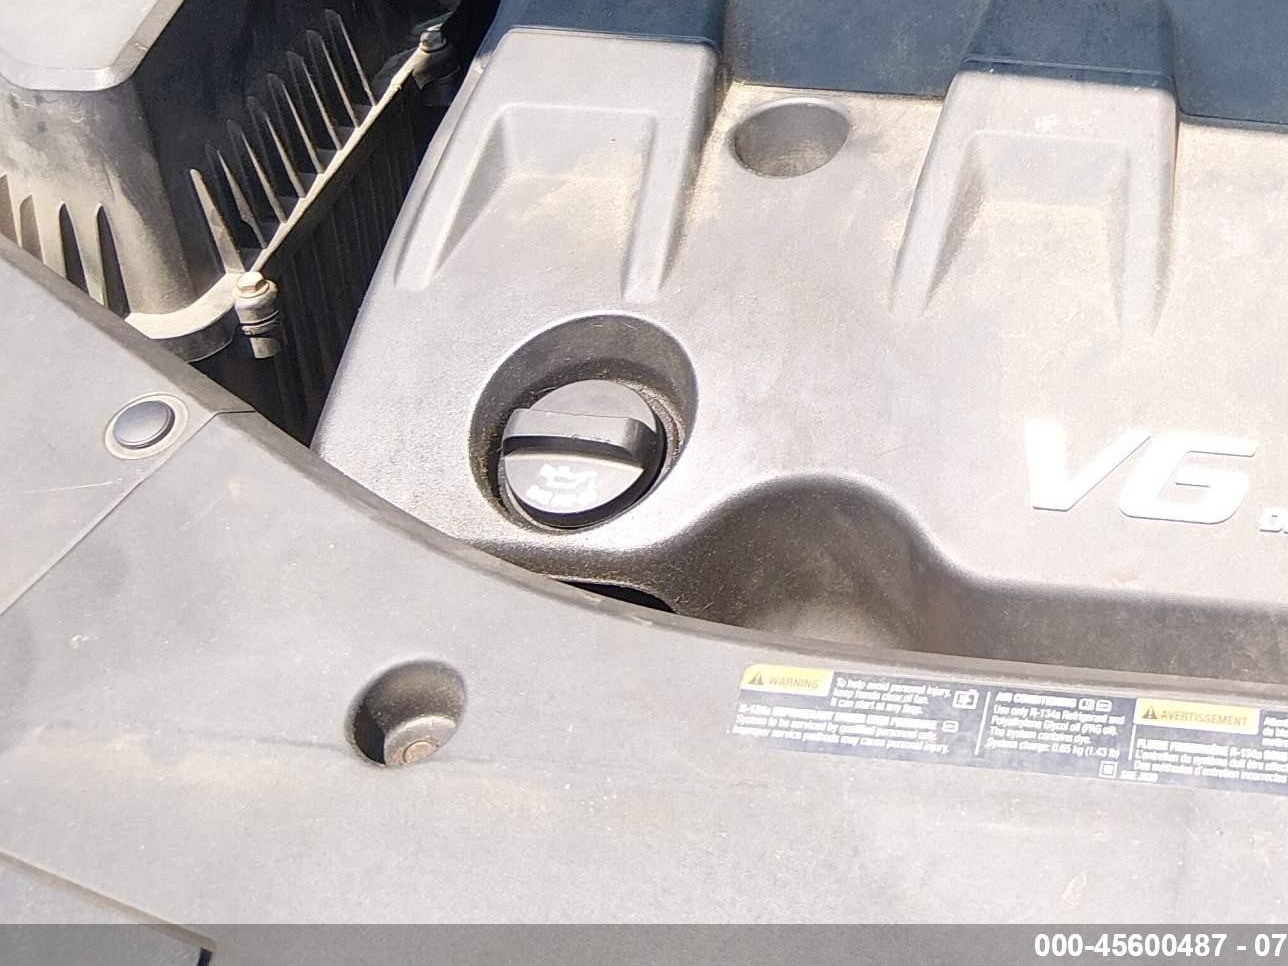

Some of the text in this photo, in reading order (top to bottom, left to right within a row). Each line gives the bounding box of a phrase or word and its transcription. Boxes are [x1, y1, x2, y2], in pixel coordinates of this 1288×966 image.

[1024, 420, 1259, 525] V6
[768, 676, 818, 689] WARNING
[1160, 710, 1247, 726] AVERTISSEMENT
